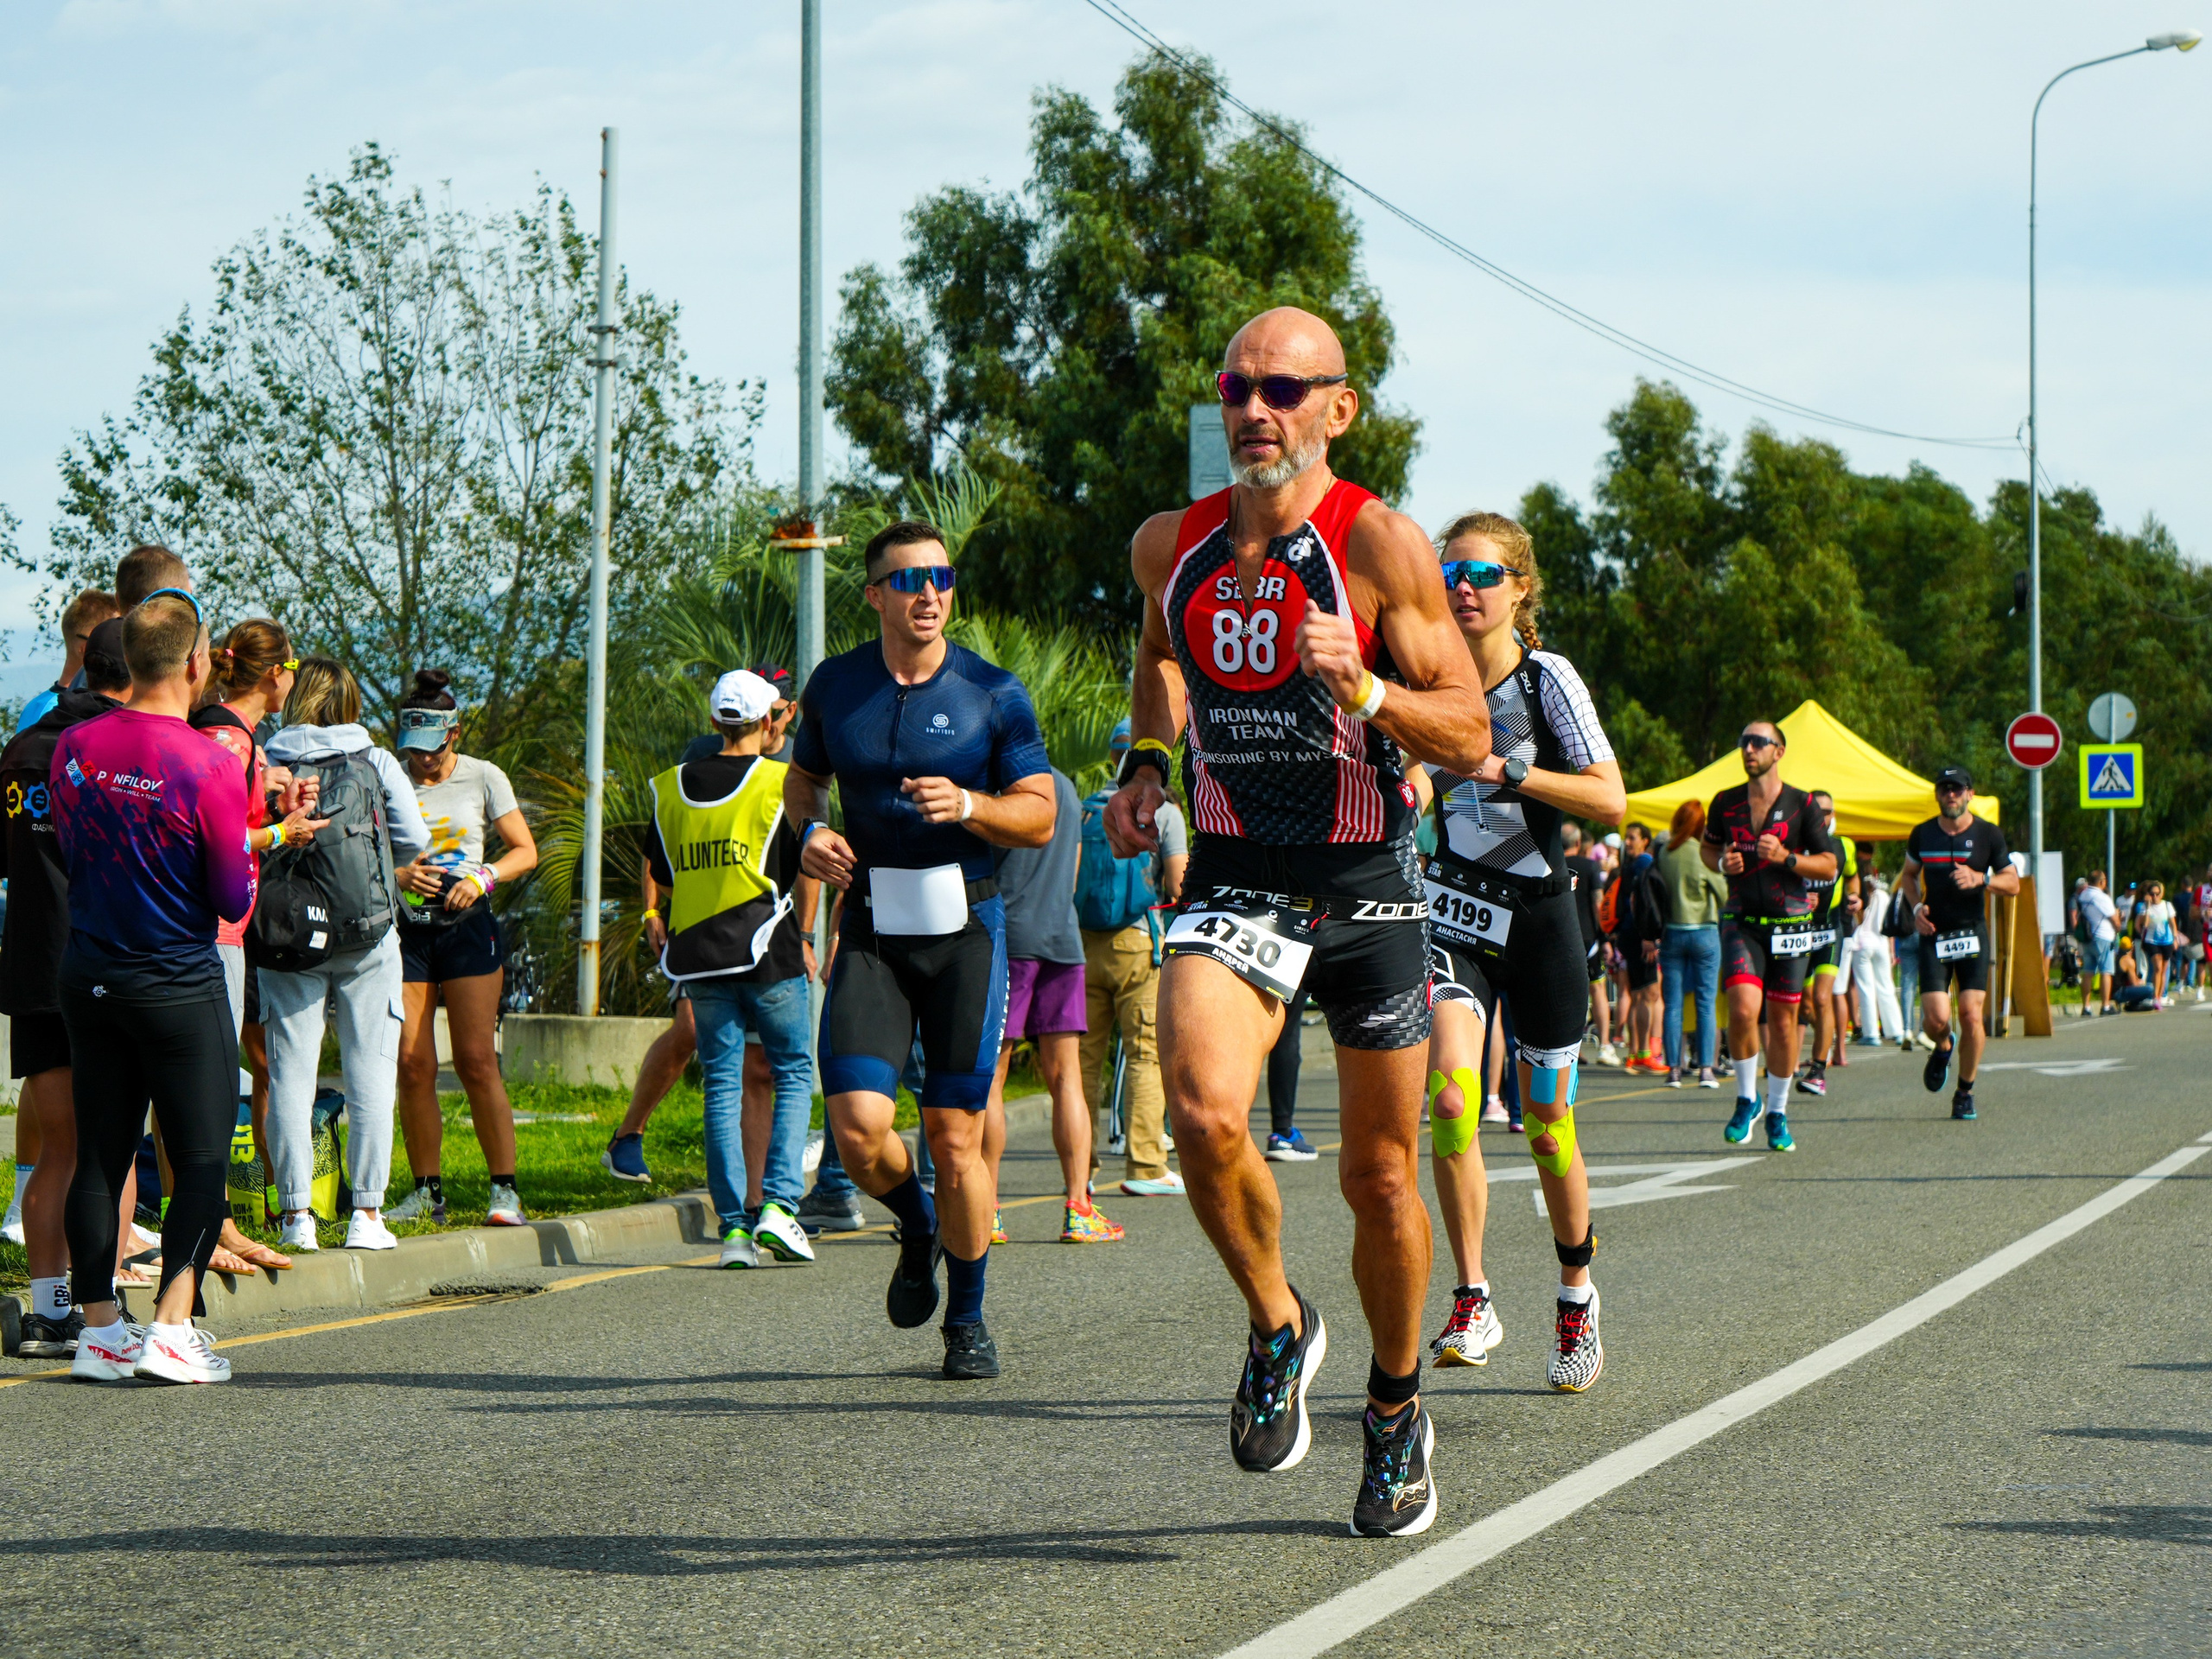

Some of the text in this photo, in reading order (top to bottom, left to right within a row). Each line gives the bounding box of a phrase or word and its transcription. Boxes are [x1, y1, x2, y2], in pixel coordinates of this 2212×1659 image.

[1211, 608, 1279, 673] 88
[1520, 671, 1535, 695] 2XU
[1210, 708, 1297, 727] IRONMAN
[1228, 725, 1286, 741] TEAM
[1192, 748, 1265, 765] SPONSORING
[1270, 751, 1291, 762] BY
[127, 789, 140, 798] WILL
[145, 794, 161, 803] TEAM
[1402, 785, 1415, 804] 88
[31, 823, 55, 833] ФАБРИК
[674, 837, 751, 873] LUNTEER
[1427, 866, 1442, 878] STAR
[1432, 893, 1493, 932] 4199
[1194, 916, 1281, 969] 4730
[1436, 925, 1478, 946] АНАСТАСИЯ
[1781, 937, 1807, 949] 4706
[1944, 940, 1971, 953] 4497
[1211, 947, 1249, 974] АНДРЕЙ
